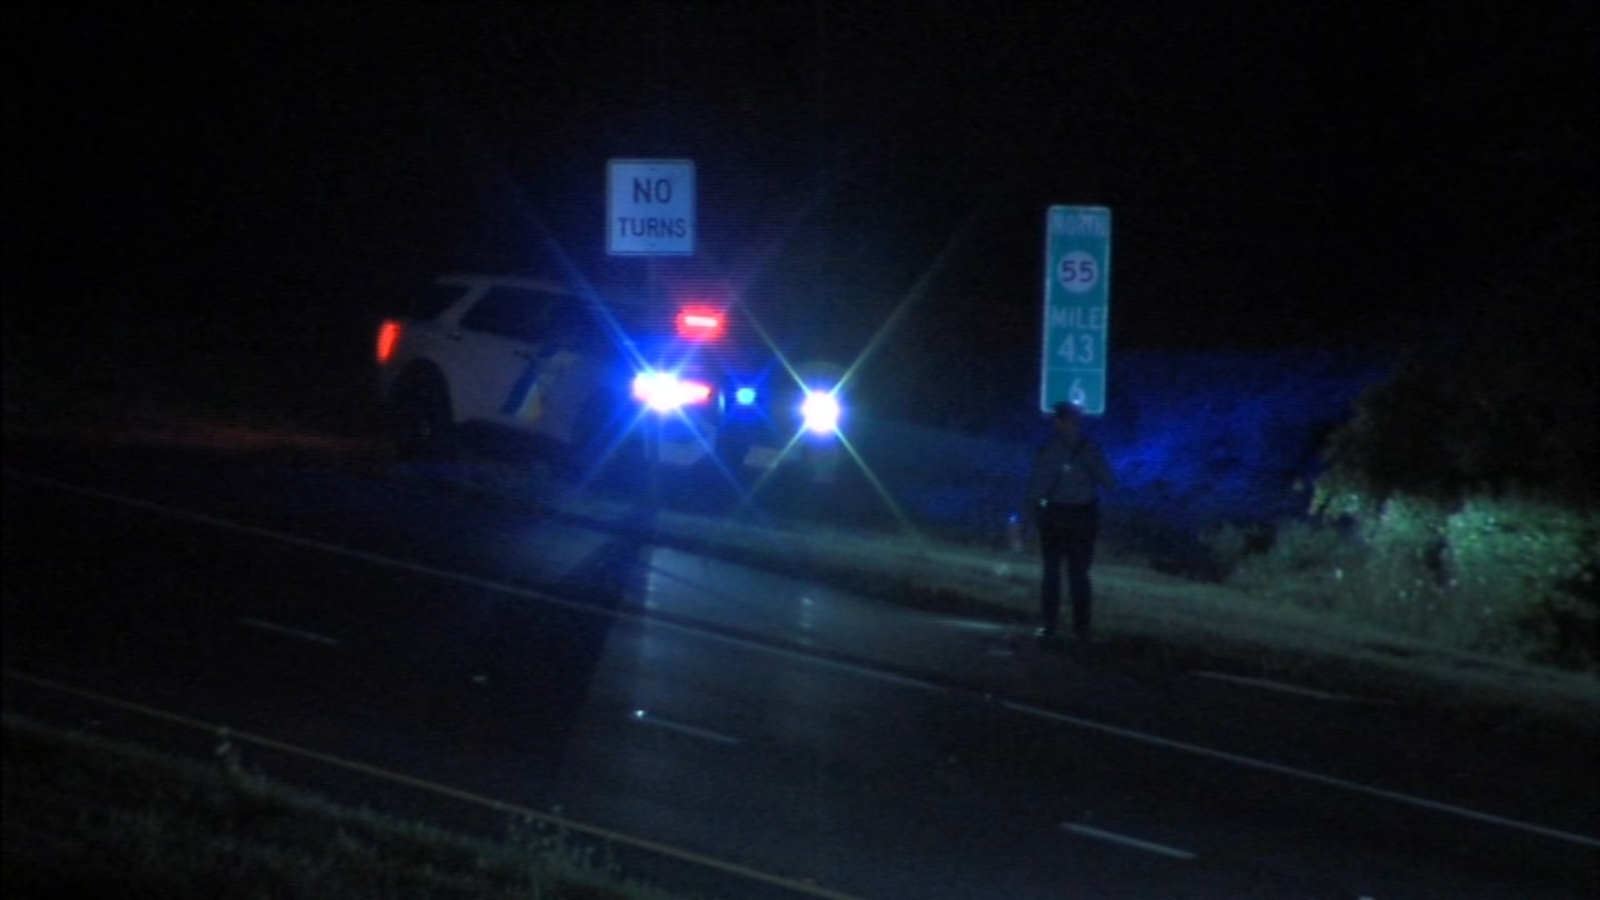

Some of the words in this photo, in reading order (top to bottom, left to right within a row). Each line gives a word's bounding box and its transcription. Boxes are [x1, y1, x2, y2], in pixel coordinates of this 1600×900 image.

[633, 178, 672, 203] NO
[618, 217, 687, 238] TURNS
[1062, 260, 1095, 282] 55
[1050, 306, 1102, 330] MILE
[1057, 334, 1095, 364] 43
[1068, 379, 1086, 406] 6
